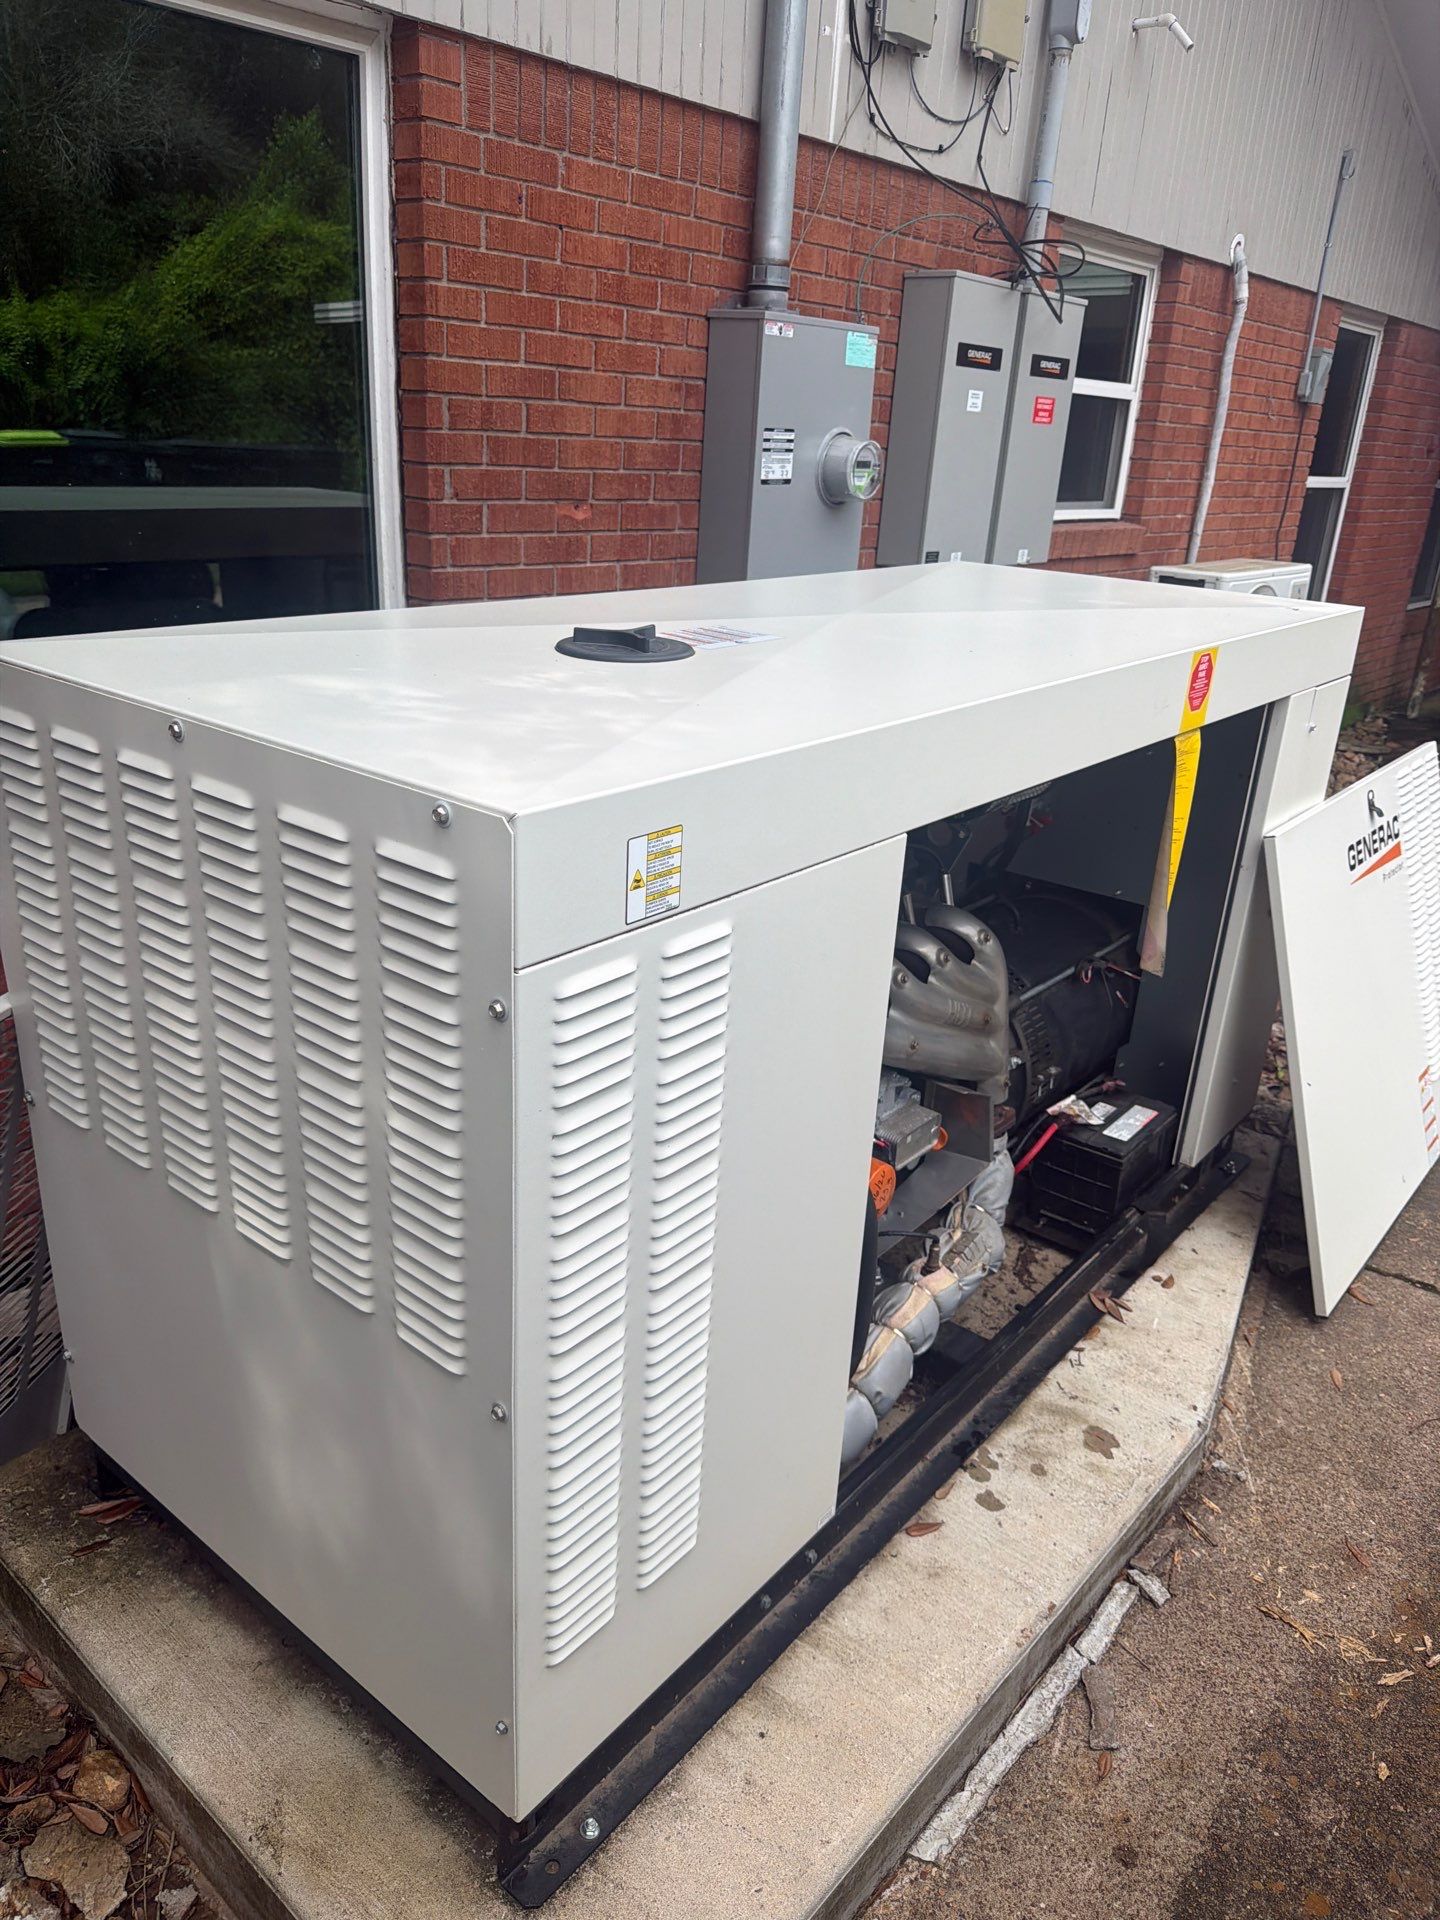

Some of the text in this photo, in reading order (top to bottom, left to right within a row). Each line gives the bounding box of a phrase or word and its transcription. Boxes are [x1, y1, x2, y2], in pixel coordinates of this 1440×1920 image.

[967, 349, 992, 360] GENERAC
[1040, 360, 1061, 370] GENERAC
[1347, 815, 1400, 872] GENERAC
